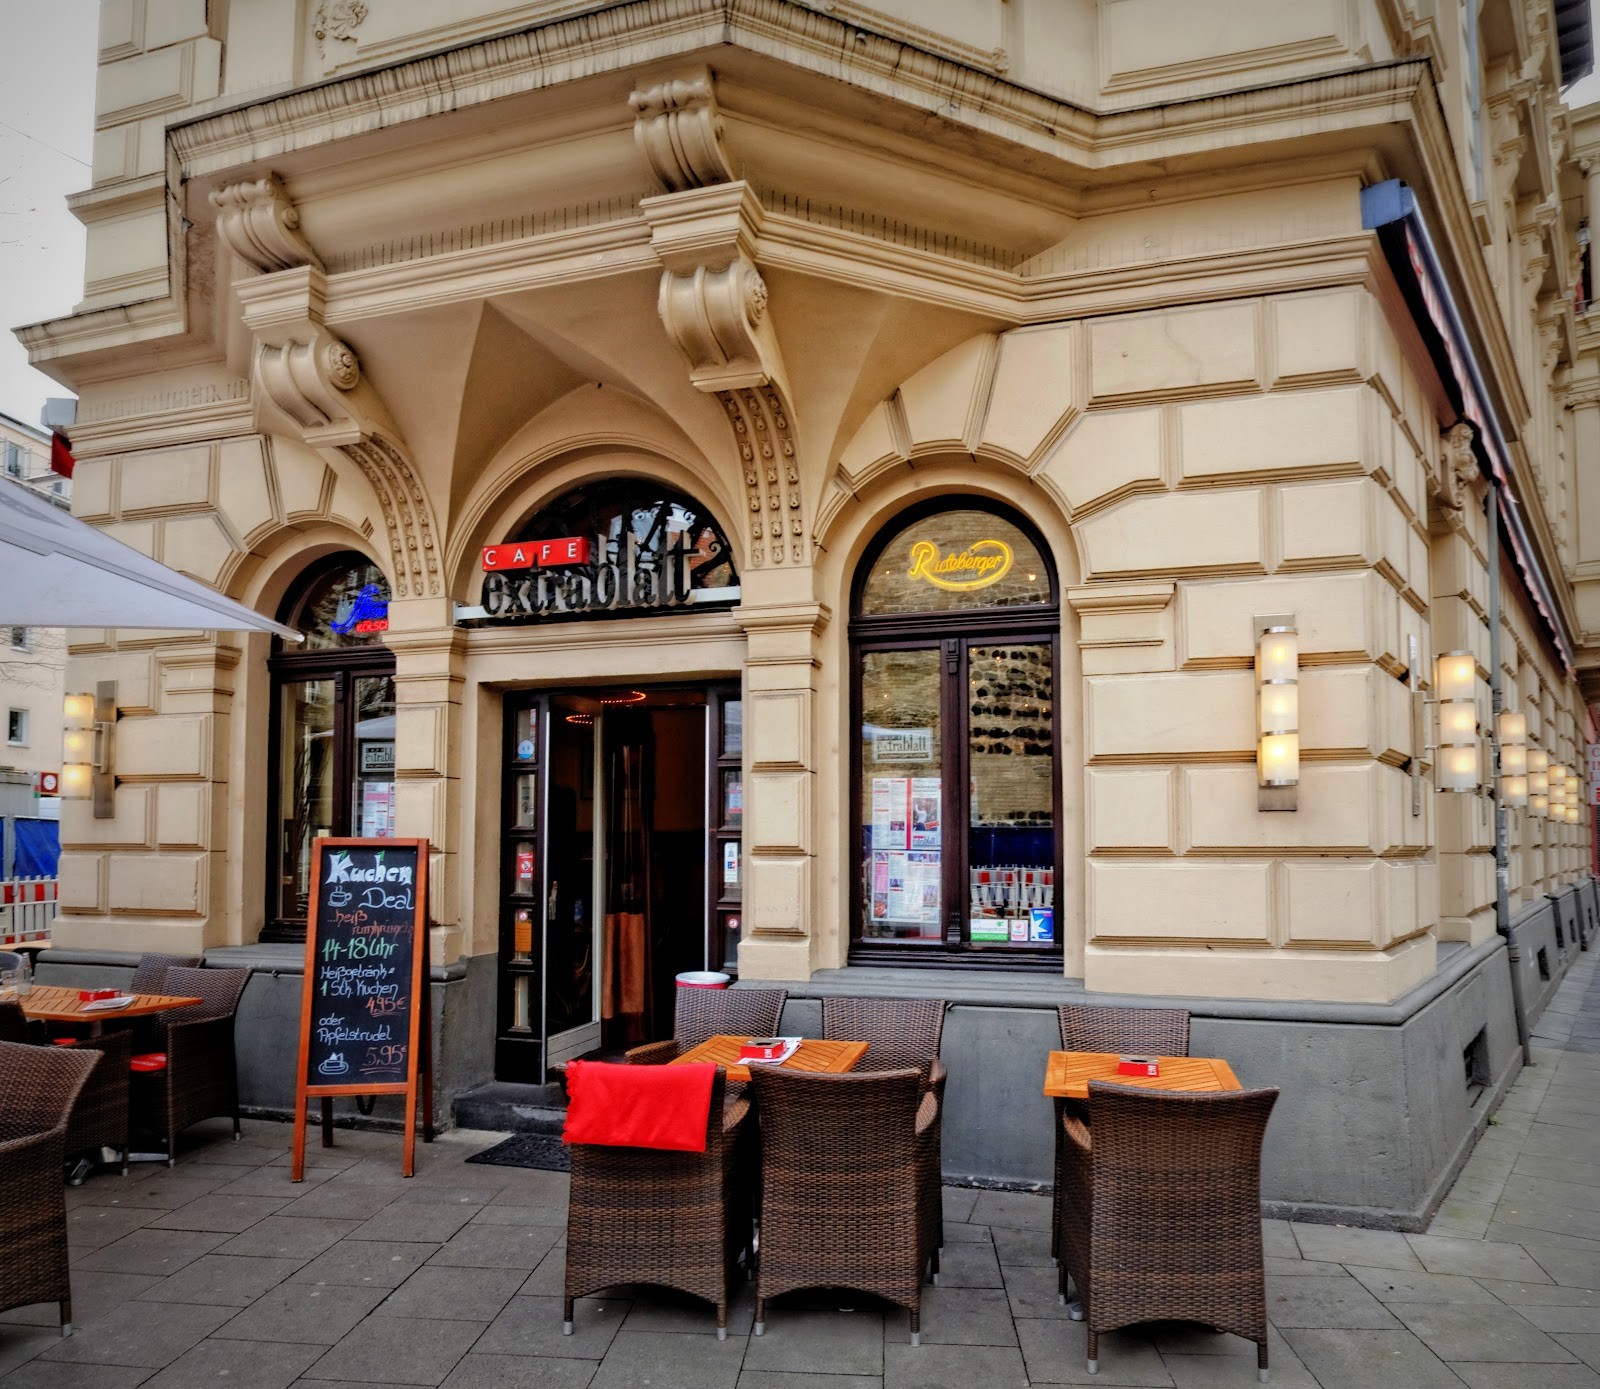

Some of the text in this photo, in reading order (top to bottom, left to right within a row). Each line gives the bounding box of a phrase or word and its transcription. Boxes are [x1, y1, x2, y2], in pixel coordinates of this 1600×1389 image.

[485, 542, 577, 565] CAFE
[482, 528, 699, 615] extrablatt
[877, 734, 926, 751] extrablatt
[325, 850, 413, 885] Kuchen
[358, 887, 415, 910] Deal
[356, 979, 398, 1001] Kuchen
[319, 1012, 345, 1026] oder
[317, 1024, 392, 1046] Apfelstrudel
